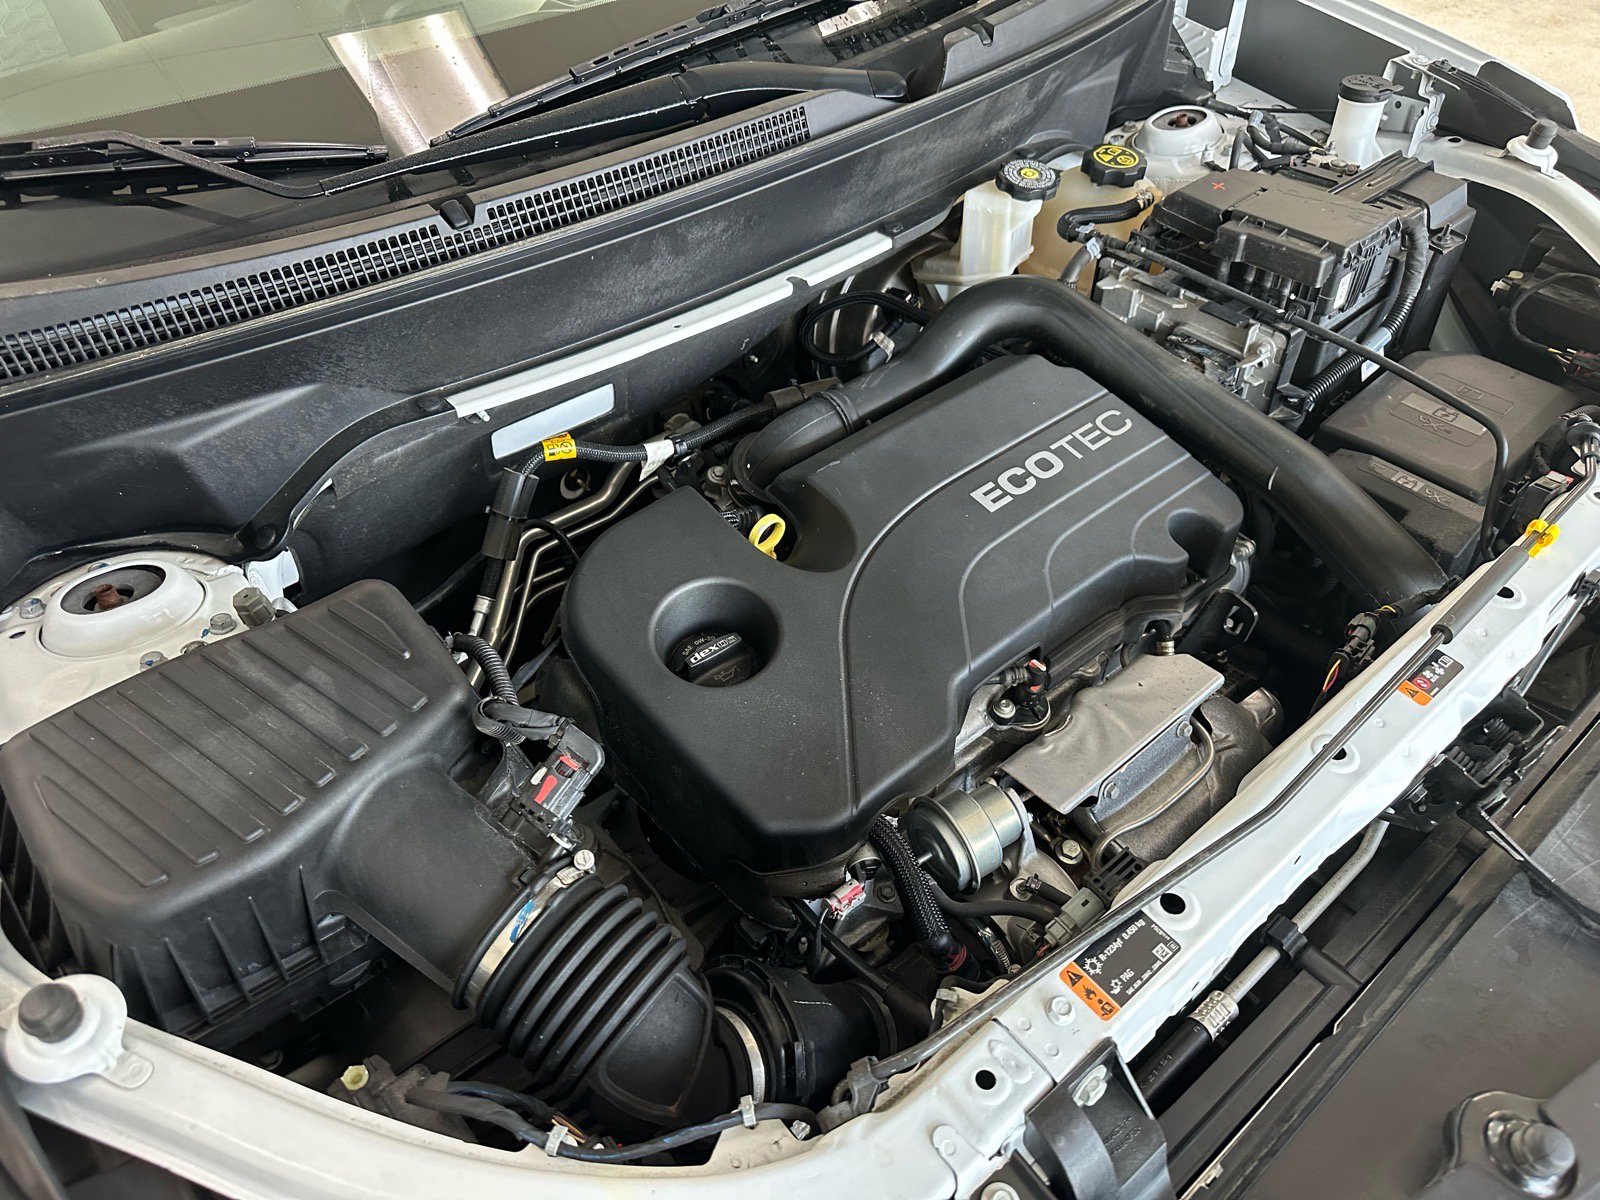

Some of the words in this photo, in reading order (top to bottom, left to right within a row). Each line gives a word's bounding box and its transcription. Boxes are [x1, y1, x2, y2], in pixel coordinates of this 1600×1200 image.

[970, 409, 1132, 513] ECOTEC
[682, 645, 694, 656] SAE
[1098, 937, 1123, 962] R-1234yf
[1135, 918, 1146, 928] kg
[1120, 968, 1135, 982] PAG
